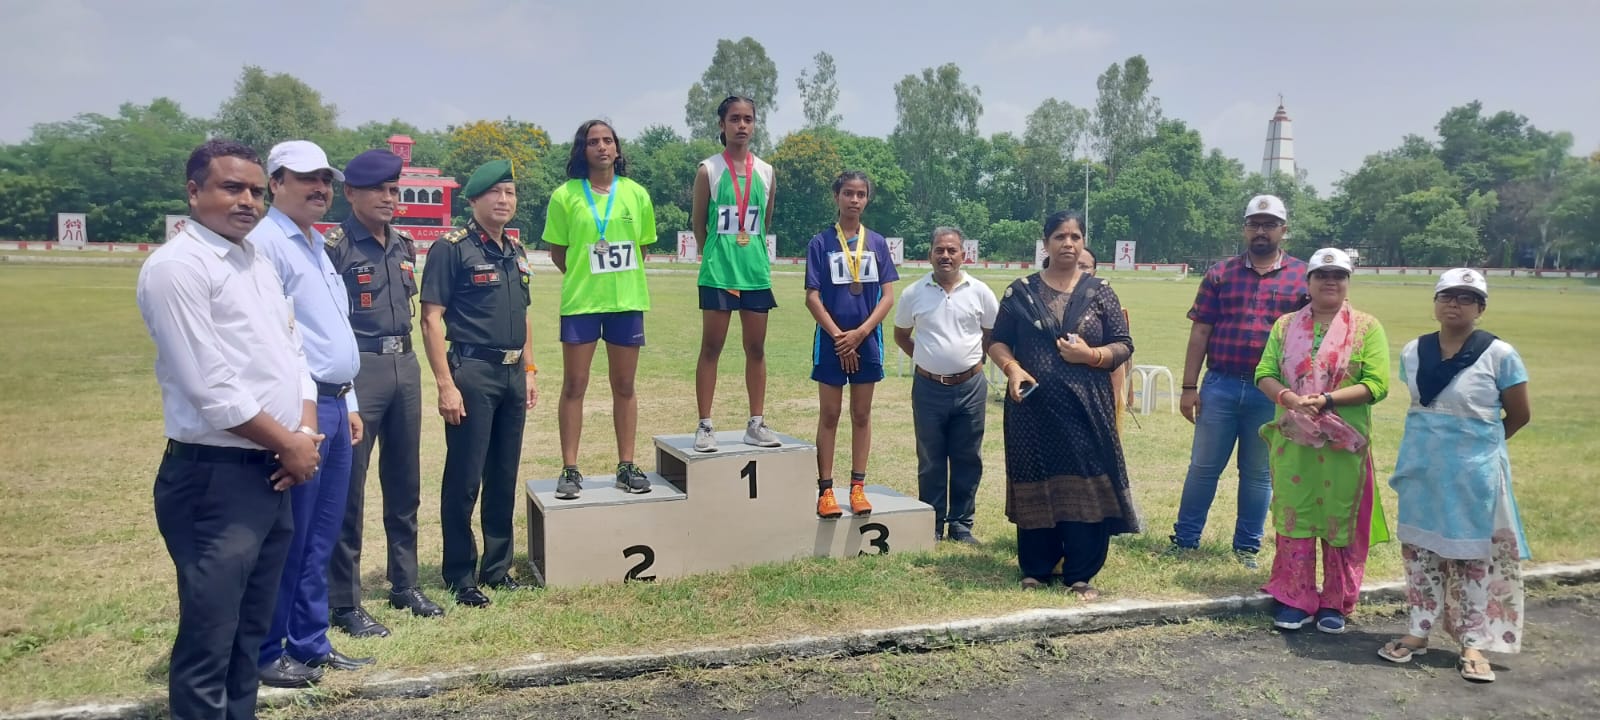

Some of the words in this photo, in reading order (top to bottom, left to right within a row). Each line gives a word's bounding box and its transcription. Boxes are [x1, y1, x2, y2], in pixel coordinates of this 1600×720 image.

[591, 244, 632, 270] 157
[833, 255, 872, 277] 17
[740, 460, 757, 499] 1
[858, 523, 890, 557] 3
[622, 544, 656, 584] 2
